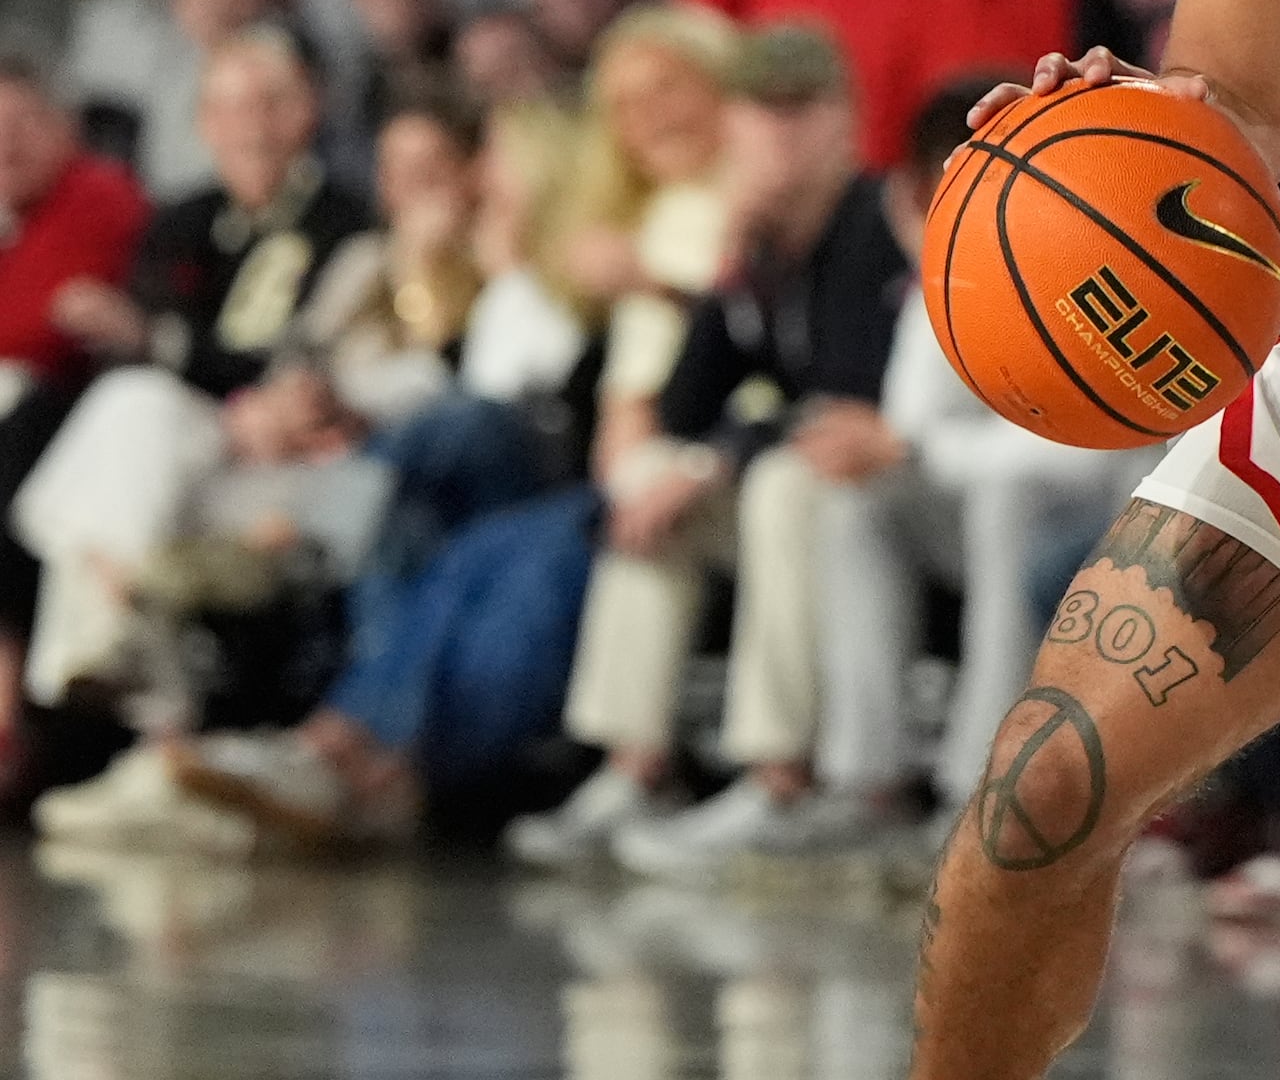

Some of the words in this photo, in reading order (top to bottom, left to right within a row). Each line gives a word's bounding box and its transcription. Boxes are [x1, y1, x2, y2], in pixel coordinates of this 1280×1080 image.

[1055, 298, 1180, 421] CHAMPIONSHIP
[1067, 264, 1221, 412] ELITE
[1048, 590, 1198, 707] 801
